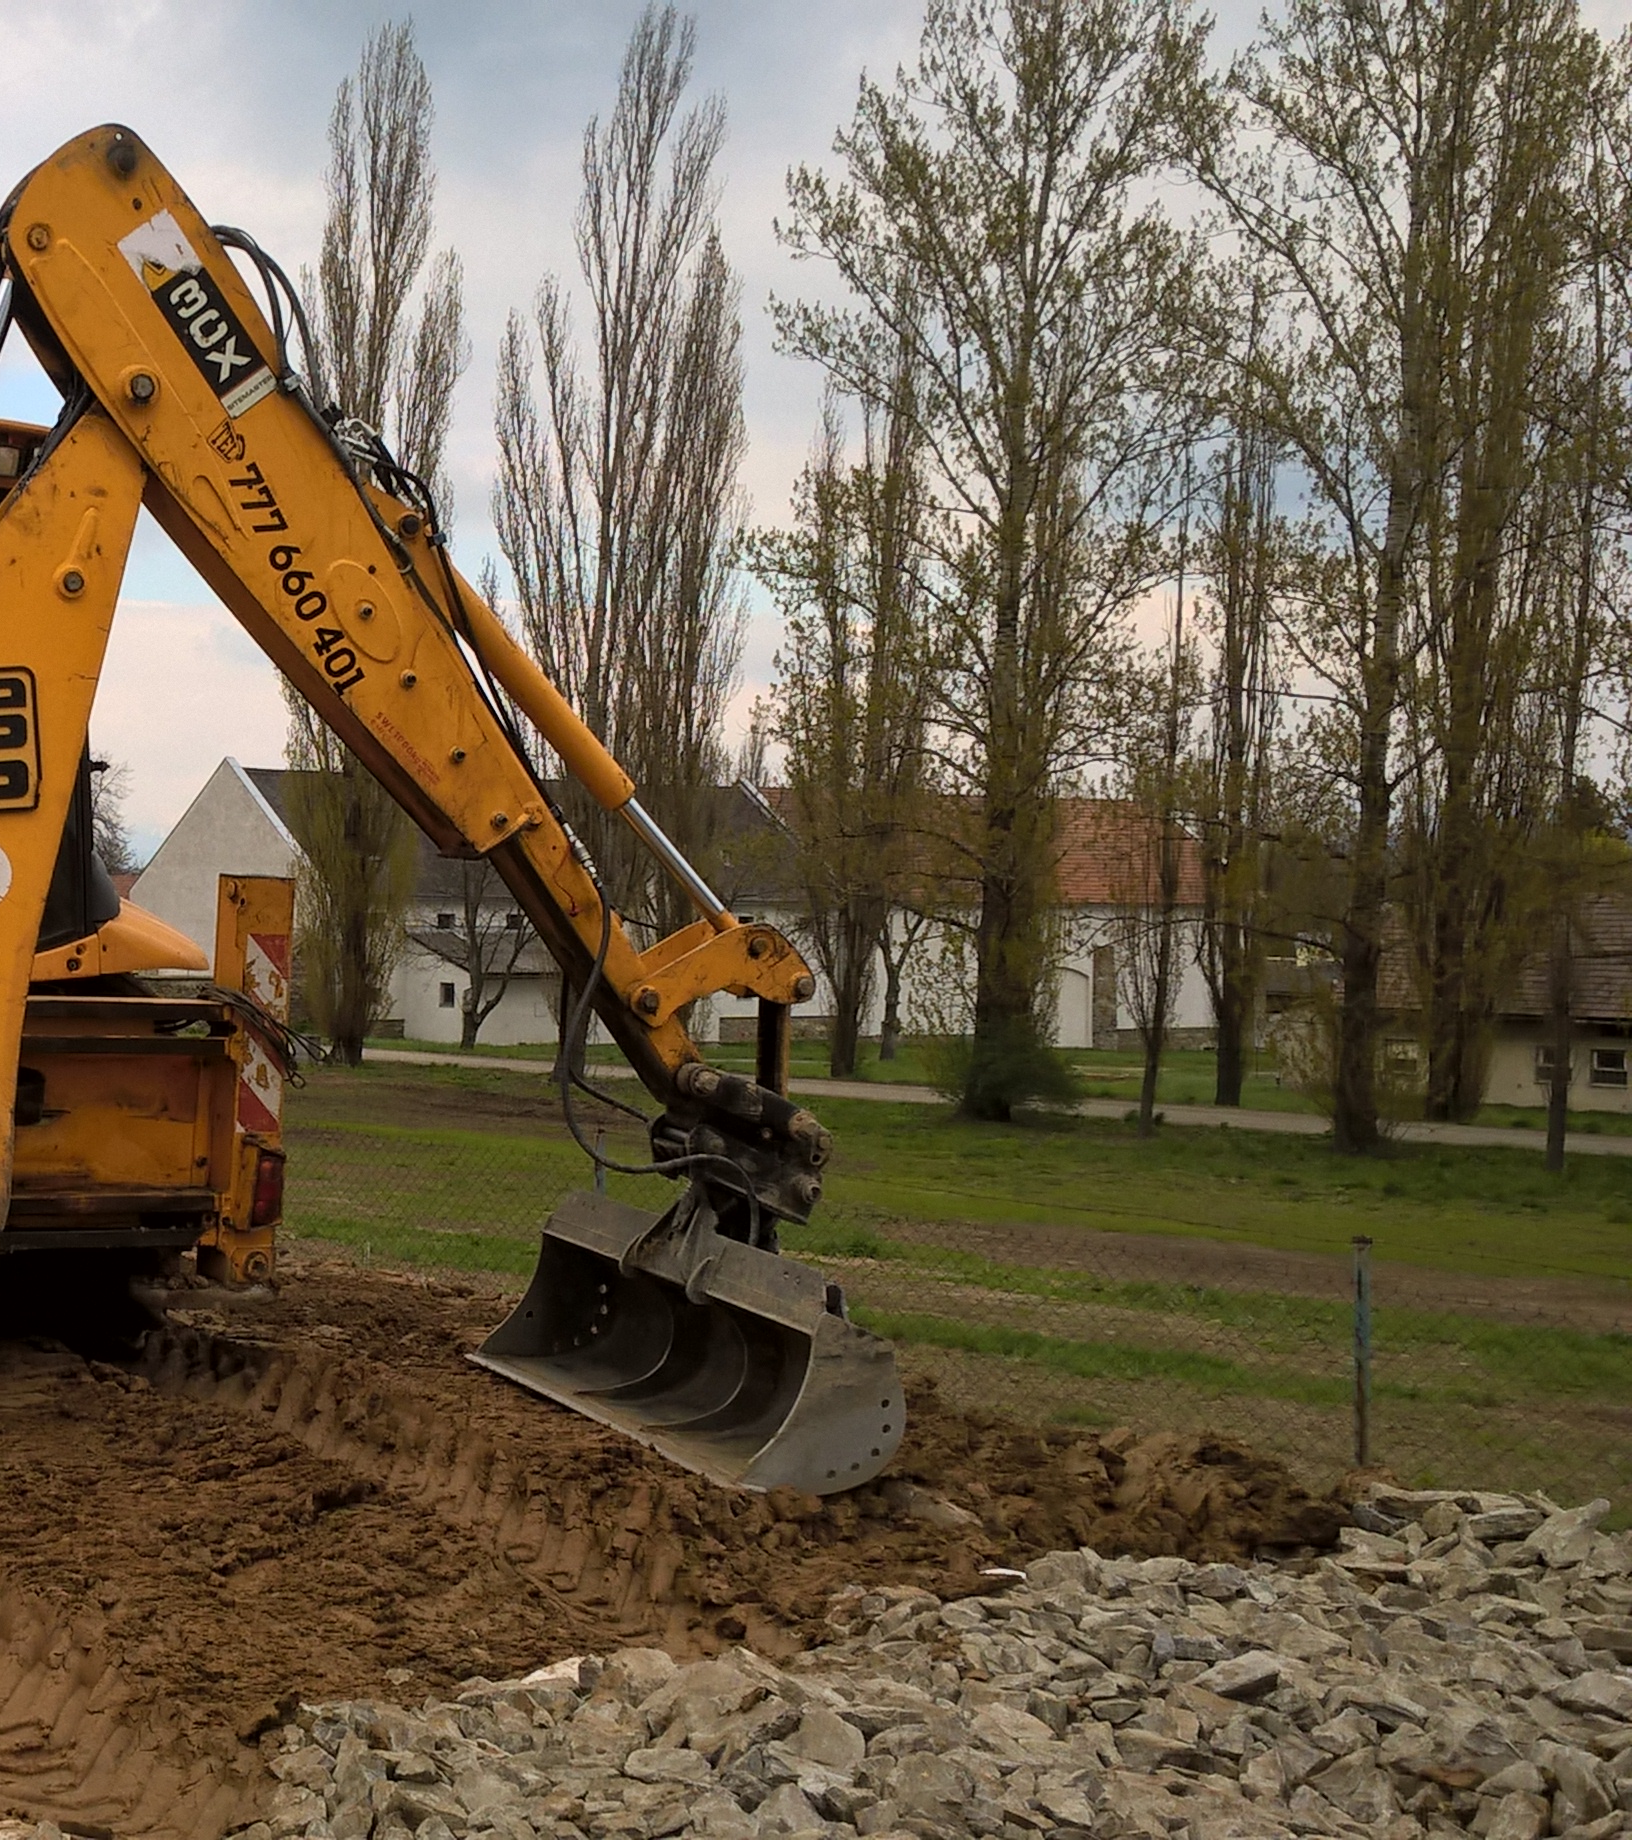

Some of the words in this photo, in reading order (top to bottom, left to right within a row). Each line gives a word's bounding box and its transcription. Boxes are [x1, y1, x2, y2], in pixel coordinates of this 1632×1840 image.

[226, 373, 274, 412] SITEMASTER
[229, 461, 288, 533] 777
[269, 545, 327, 621] 660
[313, 626, 365, 697] 401
